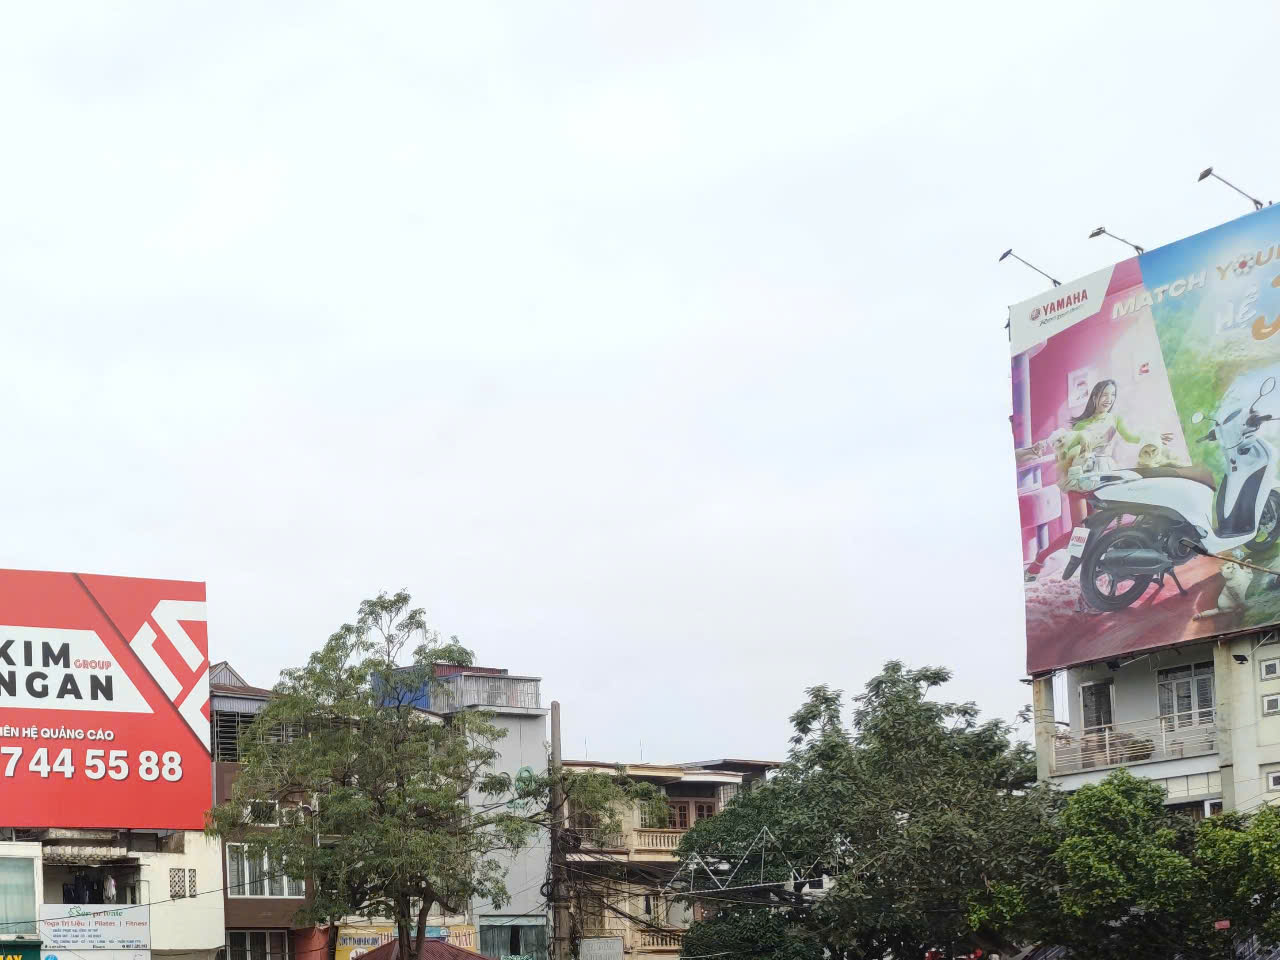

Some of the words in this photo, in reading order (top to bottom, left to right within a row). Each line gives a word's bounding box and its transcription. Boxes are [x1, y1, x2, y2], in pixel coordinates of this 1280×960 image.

[1112, 271, 1208, 319] MATCH
[1216, 243, 1280, 280] YOU
[1042, 289, 1088, 316] YAMAHA
[74, 658, 112, 671] GROUP
[22, 725, 38, 739] HỆ
[40, 725, 84, 740] QUẢNG
[87, 728, 115, 741] CÁO
[28, 747, 75, 778] 44
[84, 750, 129, 780] 55
[138, 751, 183, 781] 88
[44, 920, 60, 928] Yoga
